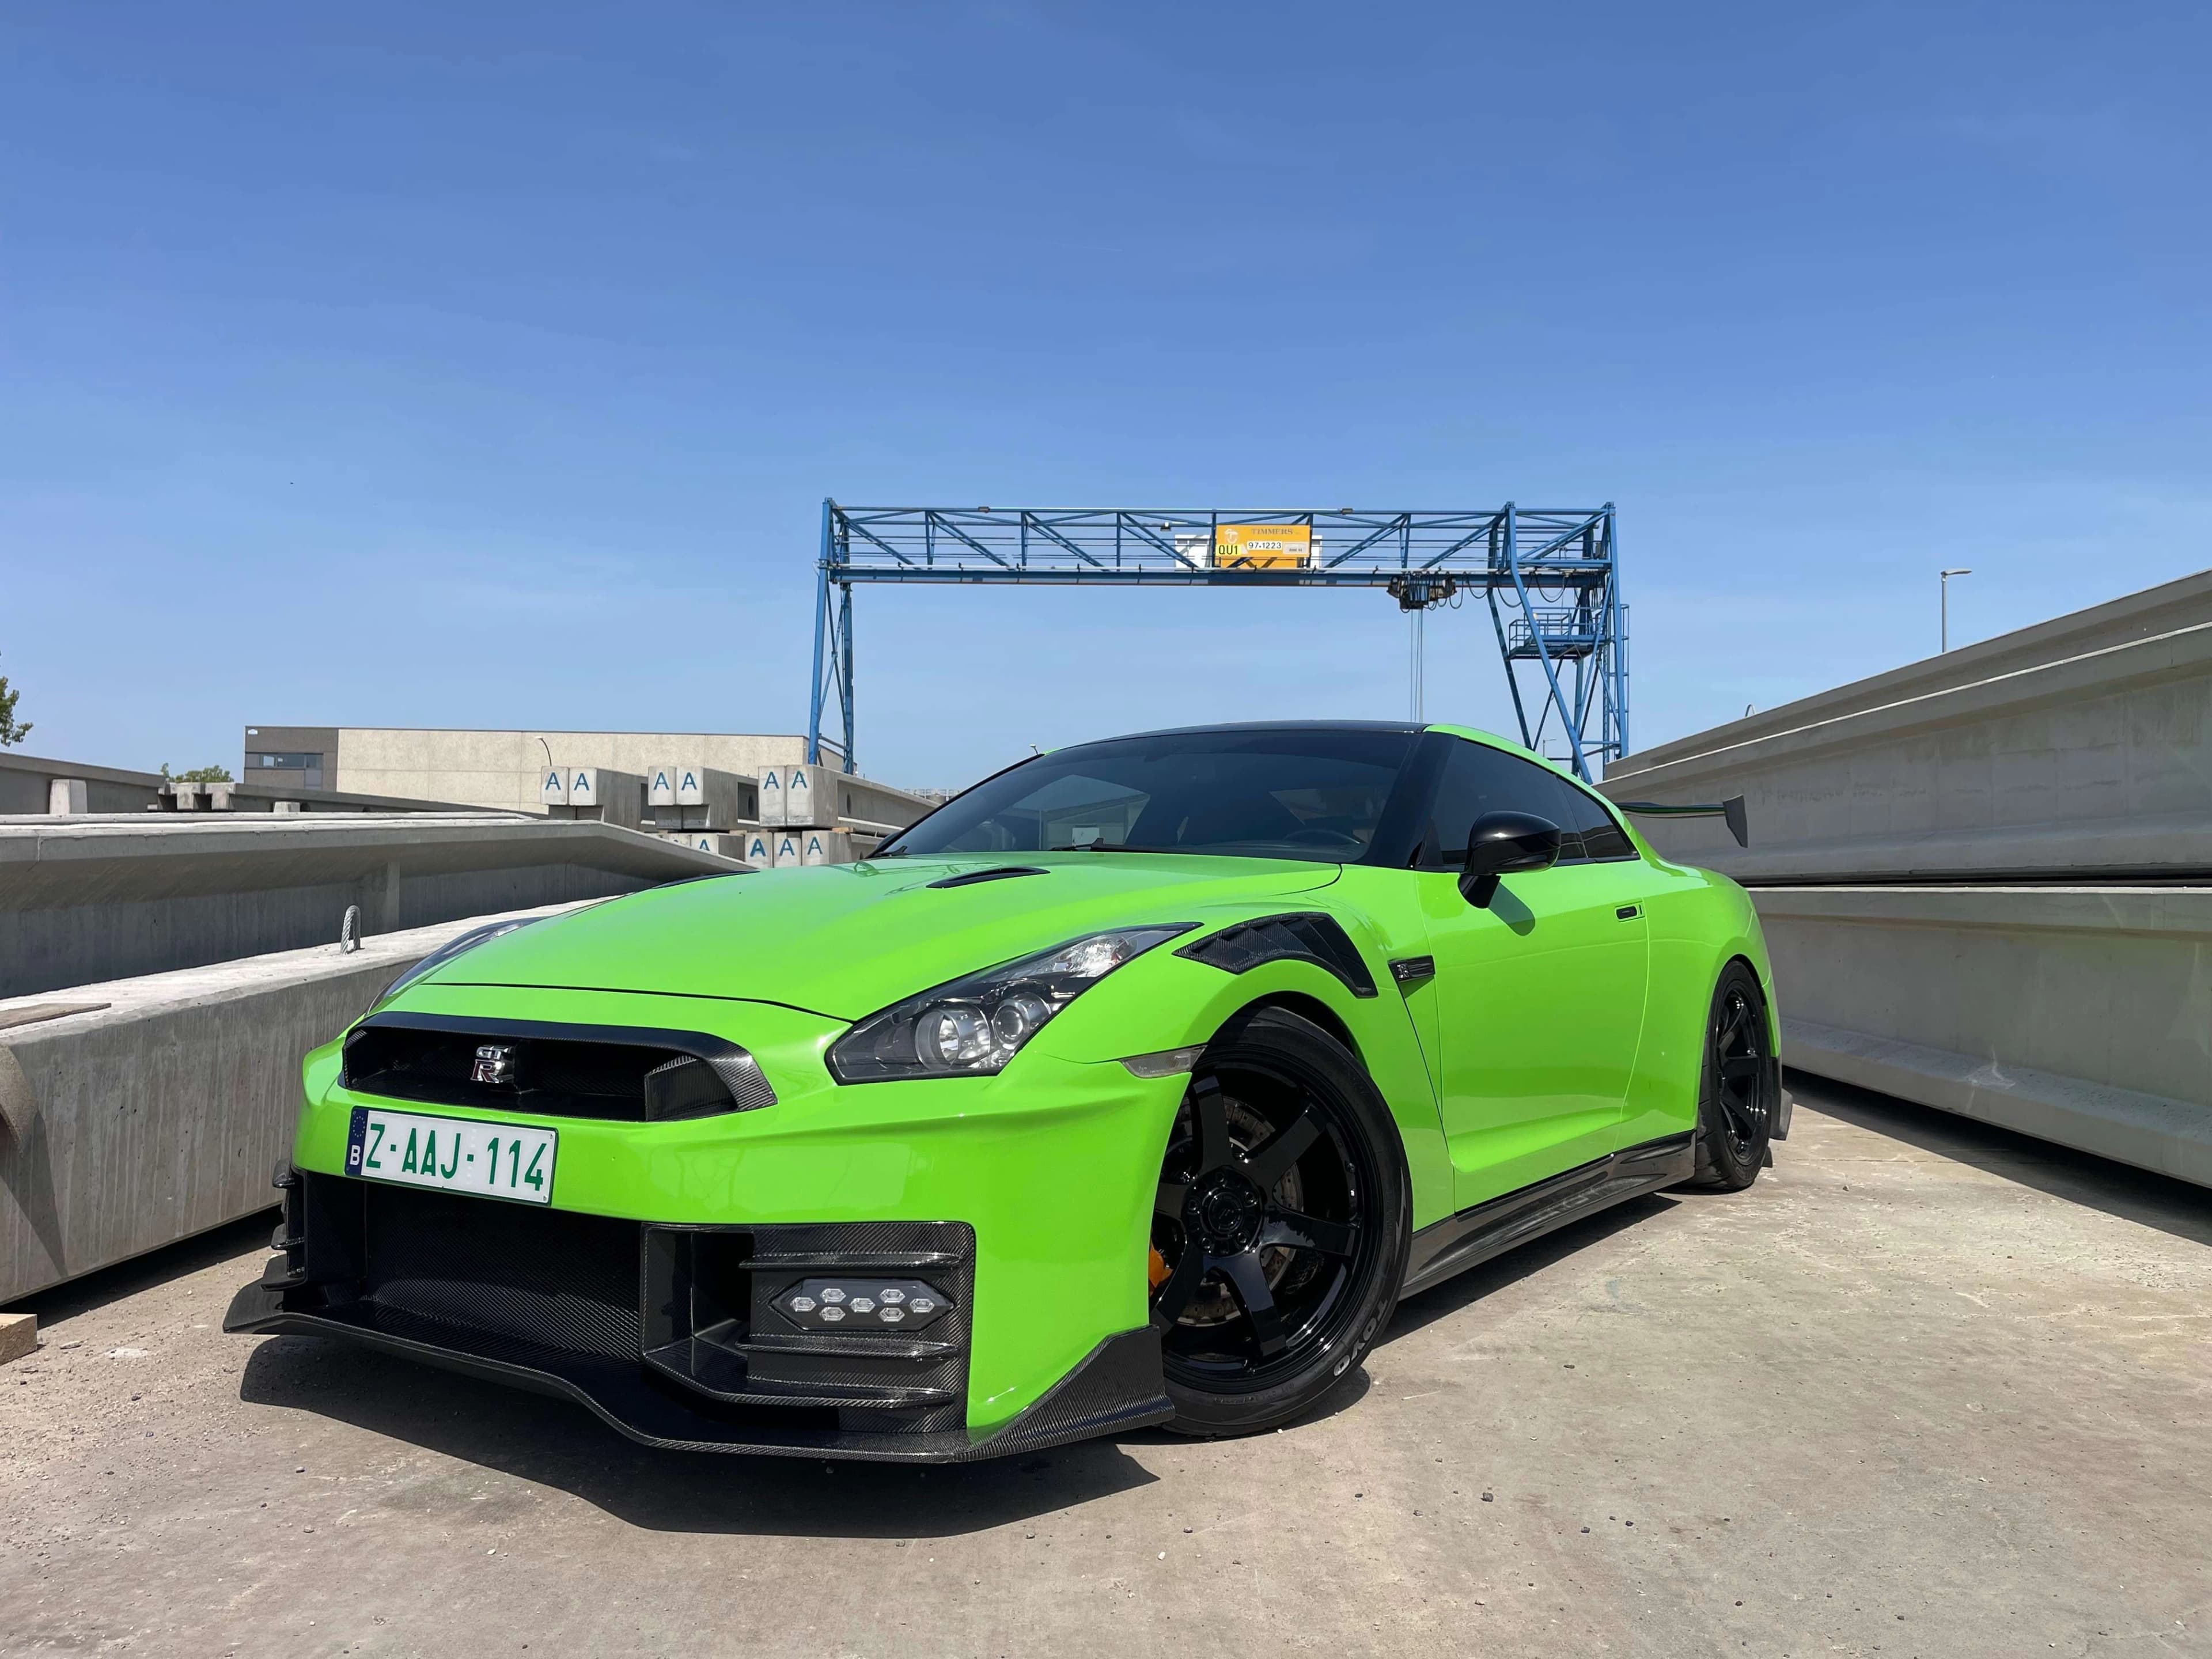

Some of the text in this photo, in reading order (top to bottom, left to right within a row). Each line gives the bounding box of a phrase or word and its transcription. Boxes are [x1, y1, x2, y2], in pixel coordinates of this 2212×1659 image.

[1218, 545, 1238, 555] QU1
[545, 772, 590, 790] A A
[653, 772, 697, 790] A A
[763, 771, 808, 789] A A
[750, 837, 823, 857] A A A
[350, 1145, 361, 1166] B
[1334, 1298, 1388, 1377] TOYO
